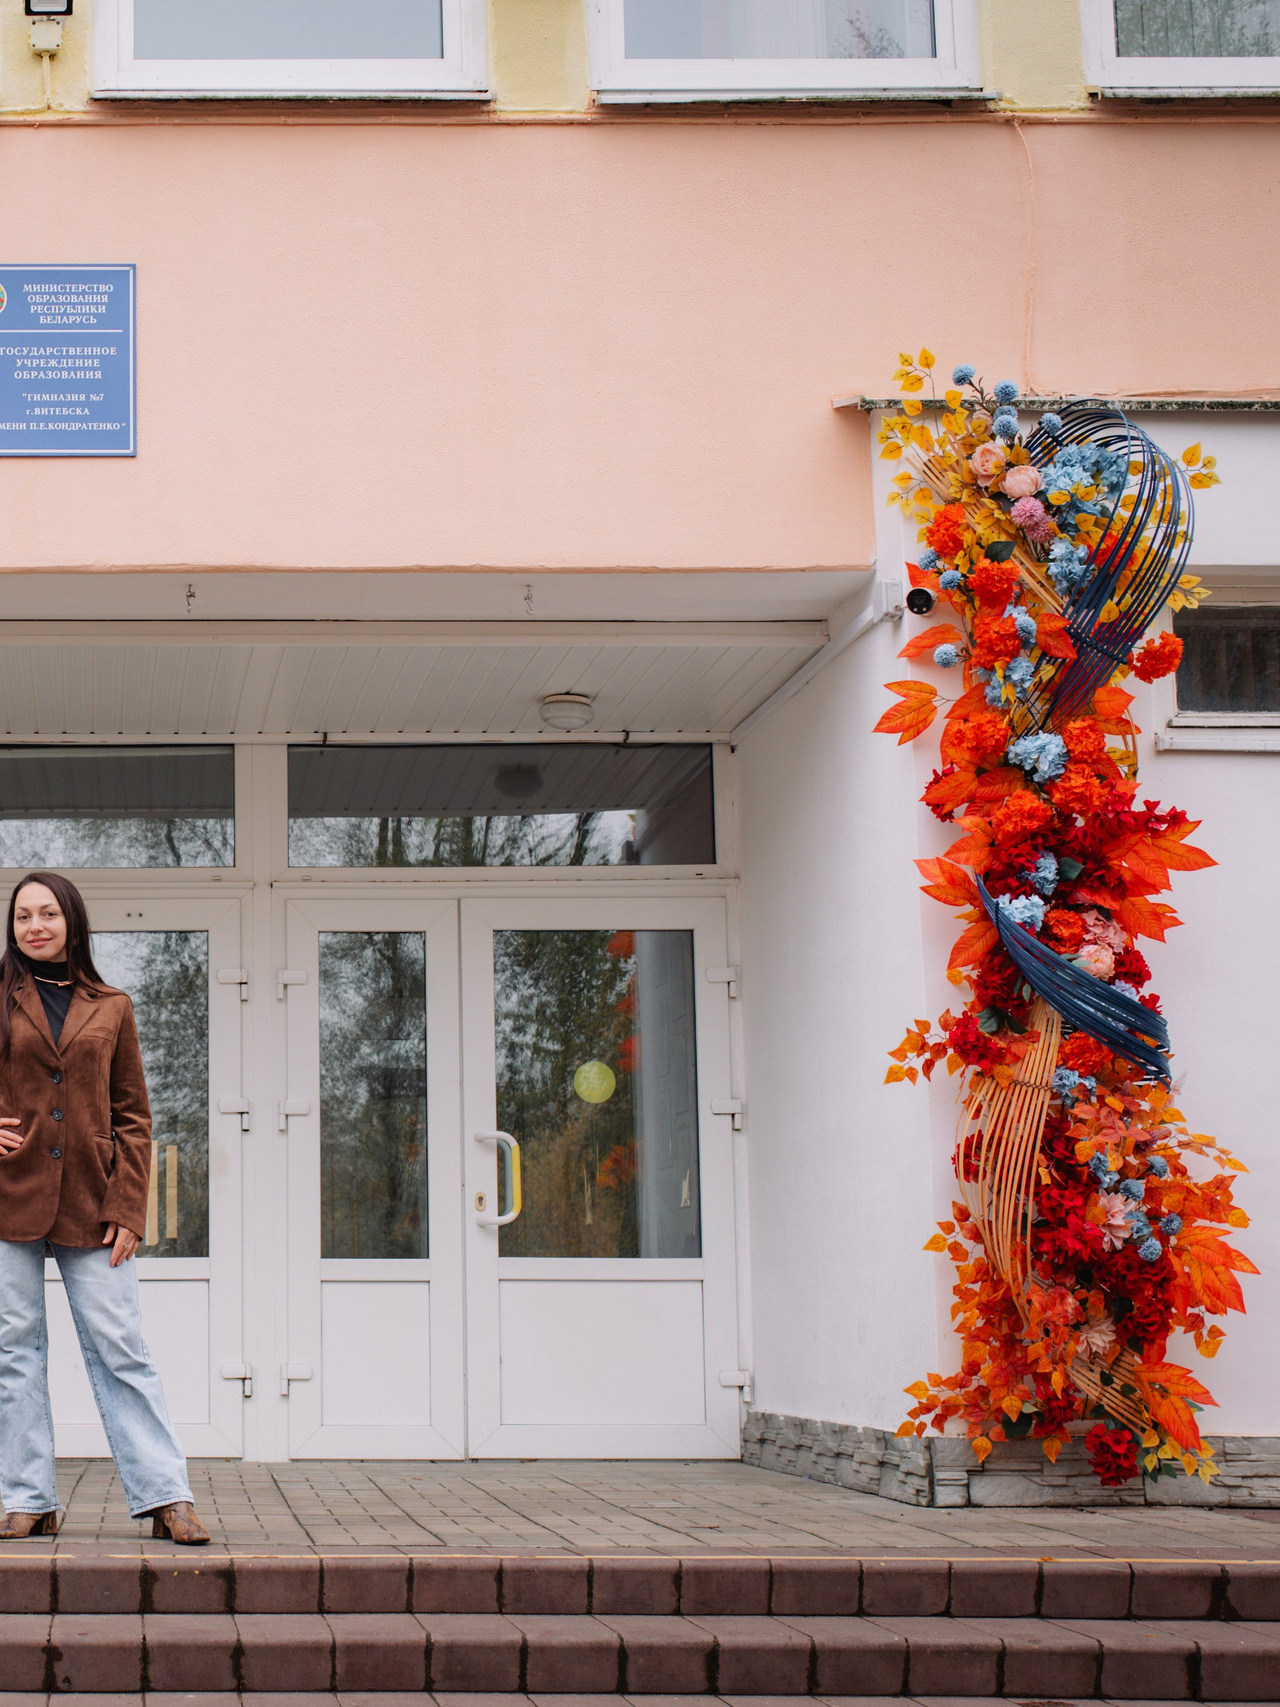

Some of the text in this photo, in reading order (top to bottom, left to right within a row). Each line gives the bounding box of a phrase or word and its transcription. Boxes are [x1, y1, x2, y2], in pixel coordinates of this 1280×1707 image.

[22, 283, 114, 292] МИНИСТЕРСТВО
[27, 294, 109, 303] ОБРАЗОВАНИЯ
[30, 304, 107, 313] РЕСПУБЛИКИ
[39, 314, 98, 323] БЕЛАРУСЬ
[0, 347, 118, 356] ГОСУДАРСТВЕННОЕ
[15, 359, 101, 368] УЧРЕЖДЕНИЕ
[13, 370, 102, 379] ОБРАЗОВАНИЯ
